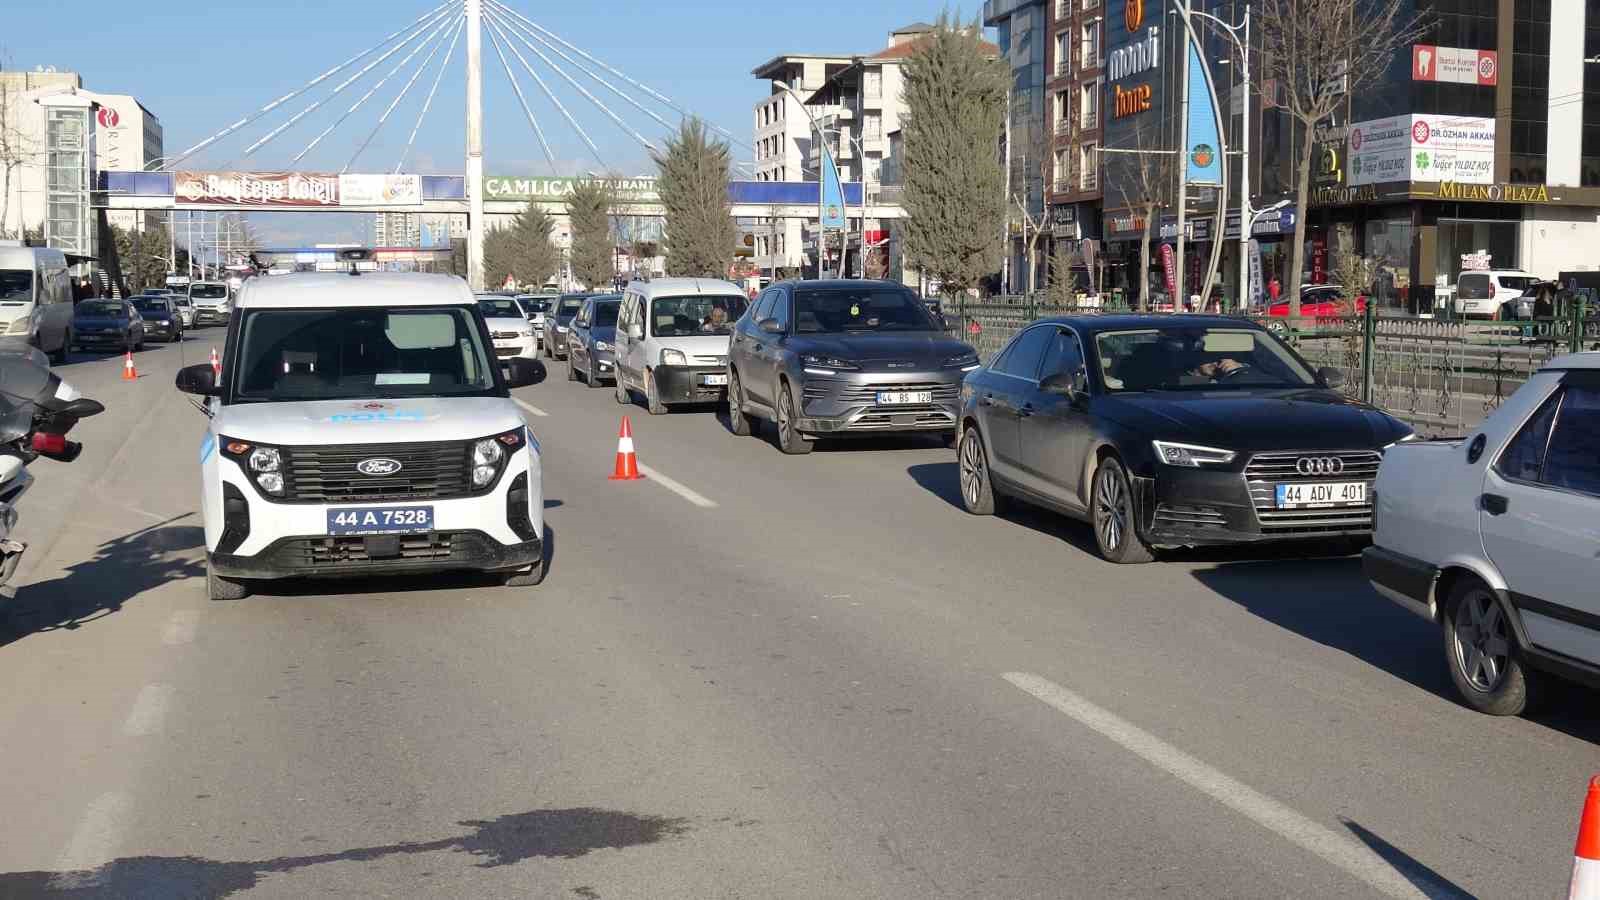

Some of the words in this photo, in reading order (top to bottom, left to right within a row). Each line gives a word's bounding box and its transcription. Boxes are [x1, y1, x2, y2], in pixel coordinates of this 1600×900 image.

[1110, 26, 1158, 81] mondi
[1115, 84, 1152, 119] home
[486, 179, 576, 198] ÇAMLICA
[1440, 180, 1500, 200] MILANO
[1504, 184, 1549, 202] PLAZA
[882, 393, 892, 402] 44
[365, 460, 394, 473] Ford
[1286, 487, 1301, 501] 44
[1310, 485, 1333, 501] ADV
[1341, 484, 1363, 500] 401
[335, 512, 358, 526] 44
[363, 511, 378, 526] A
[383, 510, 427, 525] 7528
